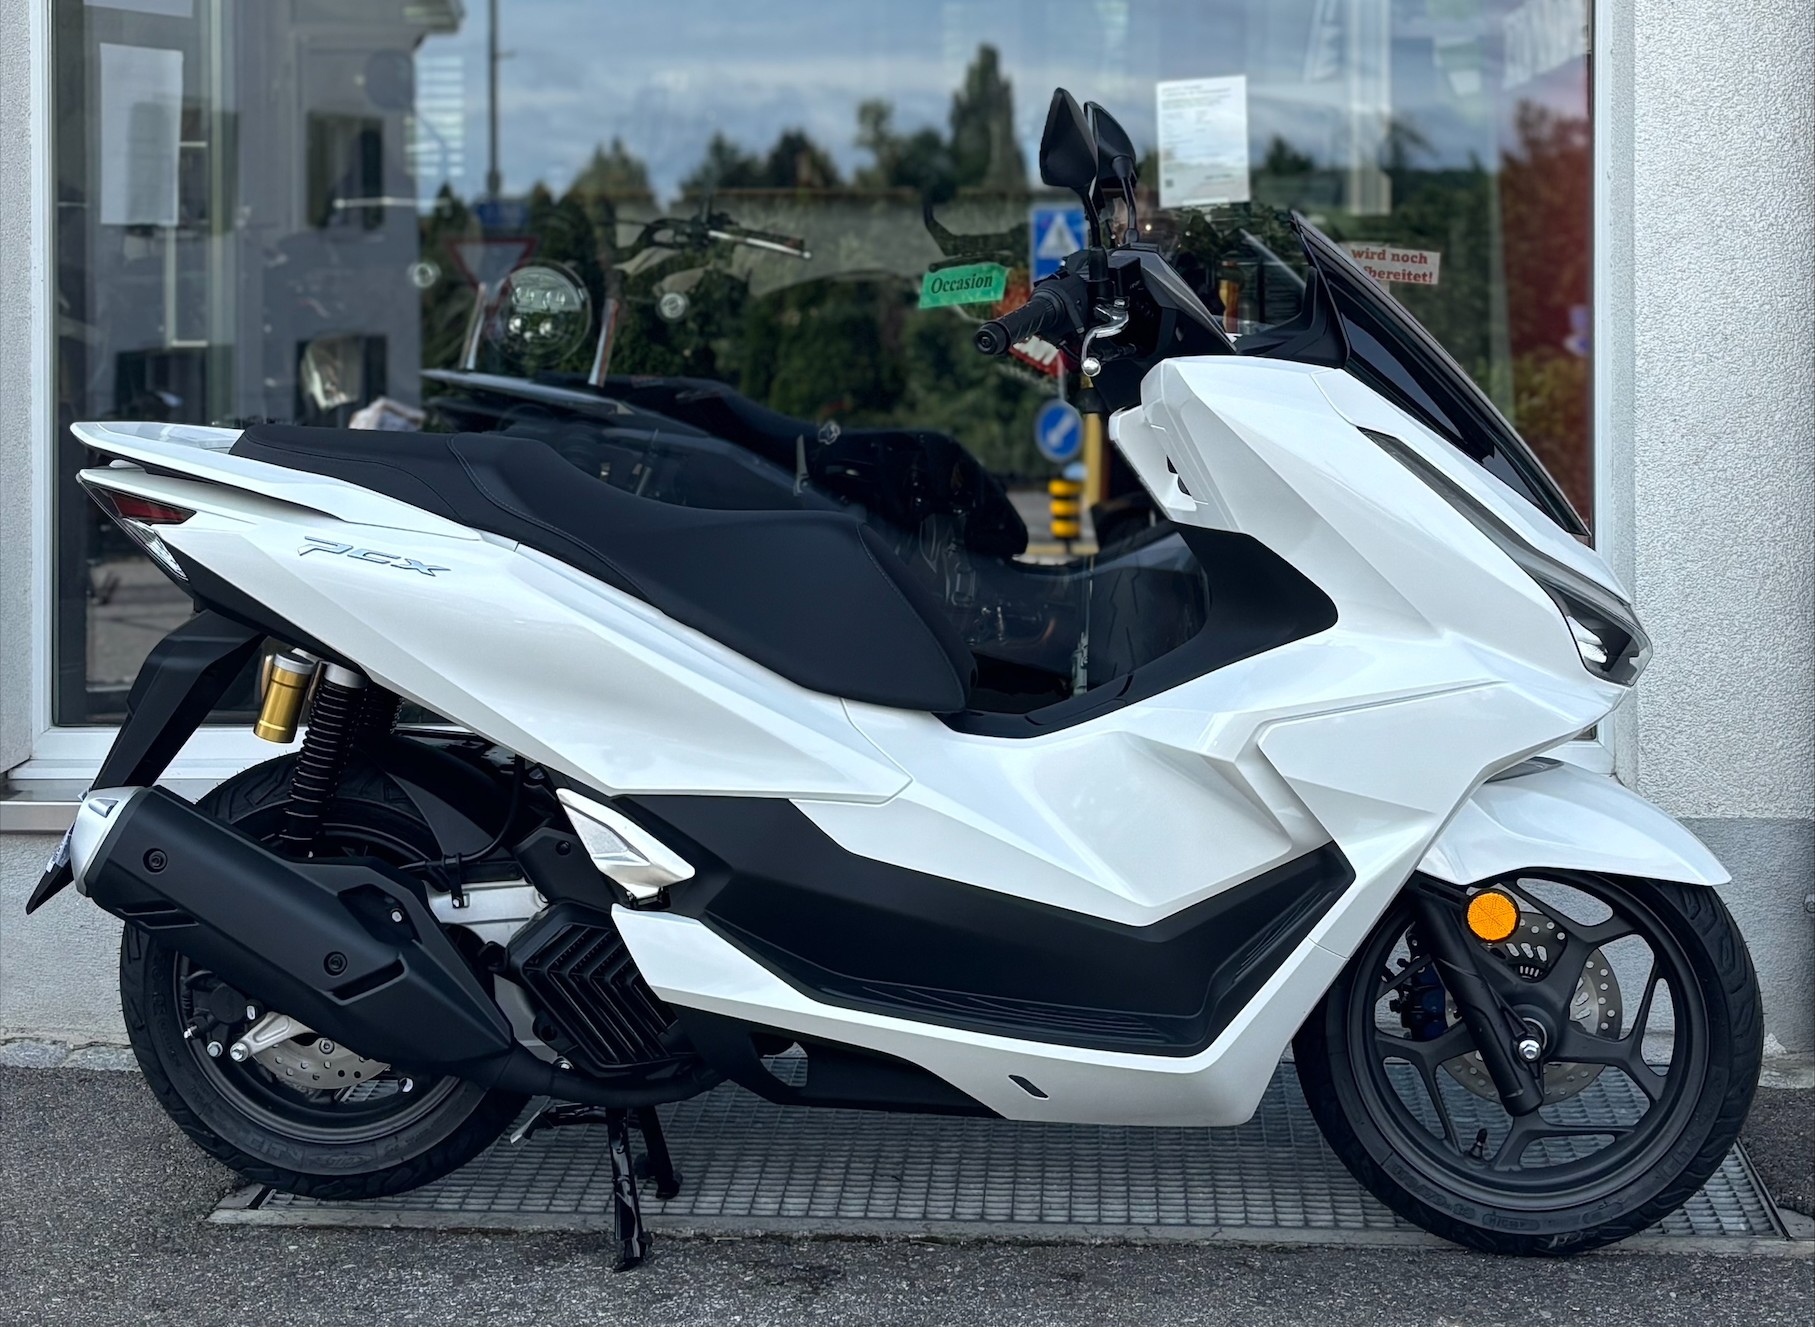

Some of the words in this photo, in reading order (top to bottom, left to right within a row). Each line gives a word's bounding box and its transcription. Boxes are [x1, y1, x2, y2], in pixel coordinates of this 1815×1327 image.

[1351, 247, 1387, 261] wird
[1391, 252, 1429, 265] noch
[930, 273, 993, 295] Occasion
[297, 535, 452, 577] PCX
